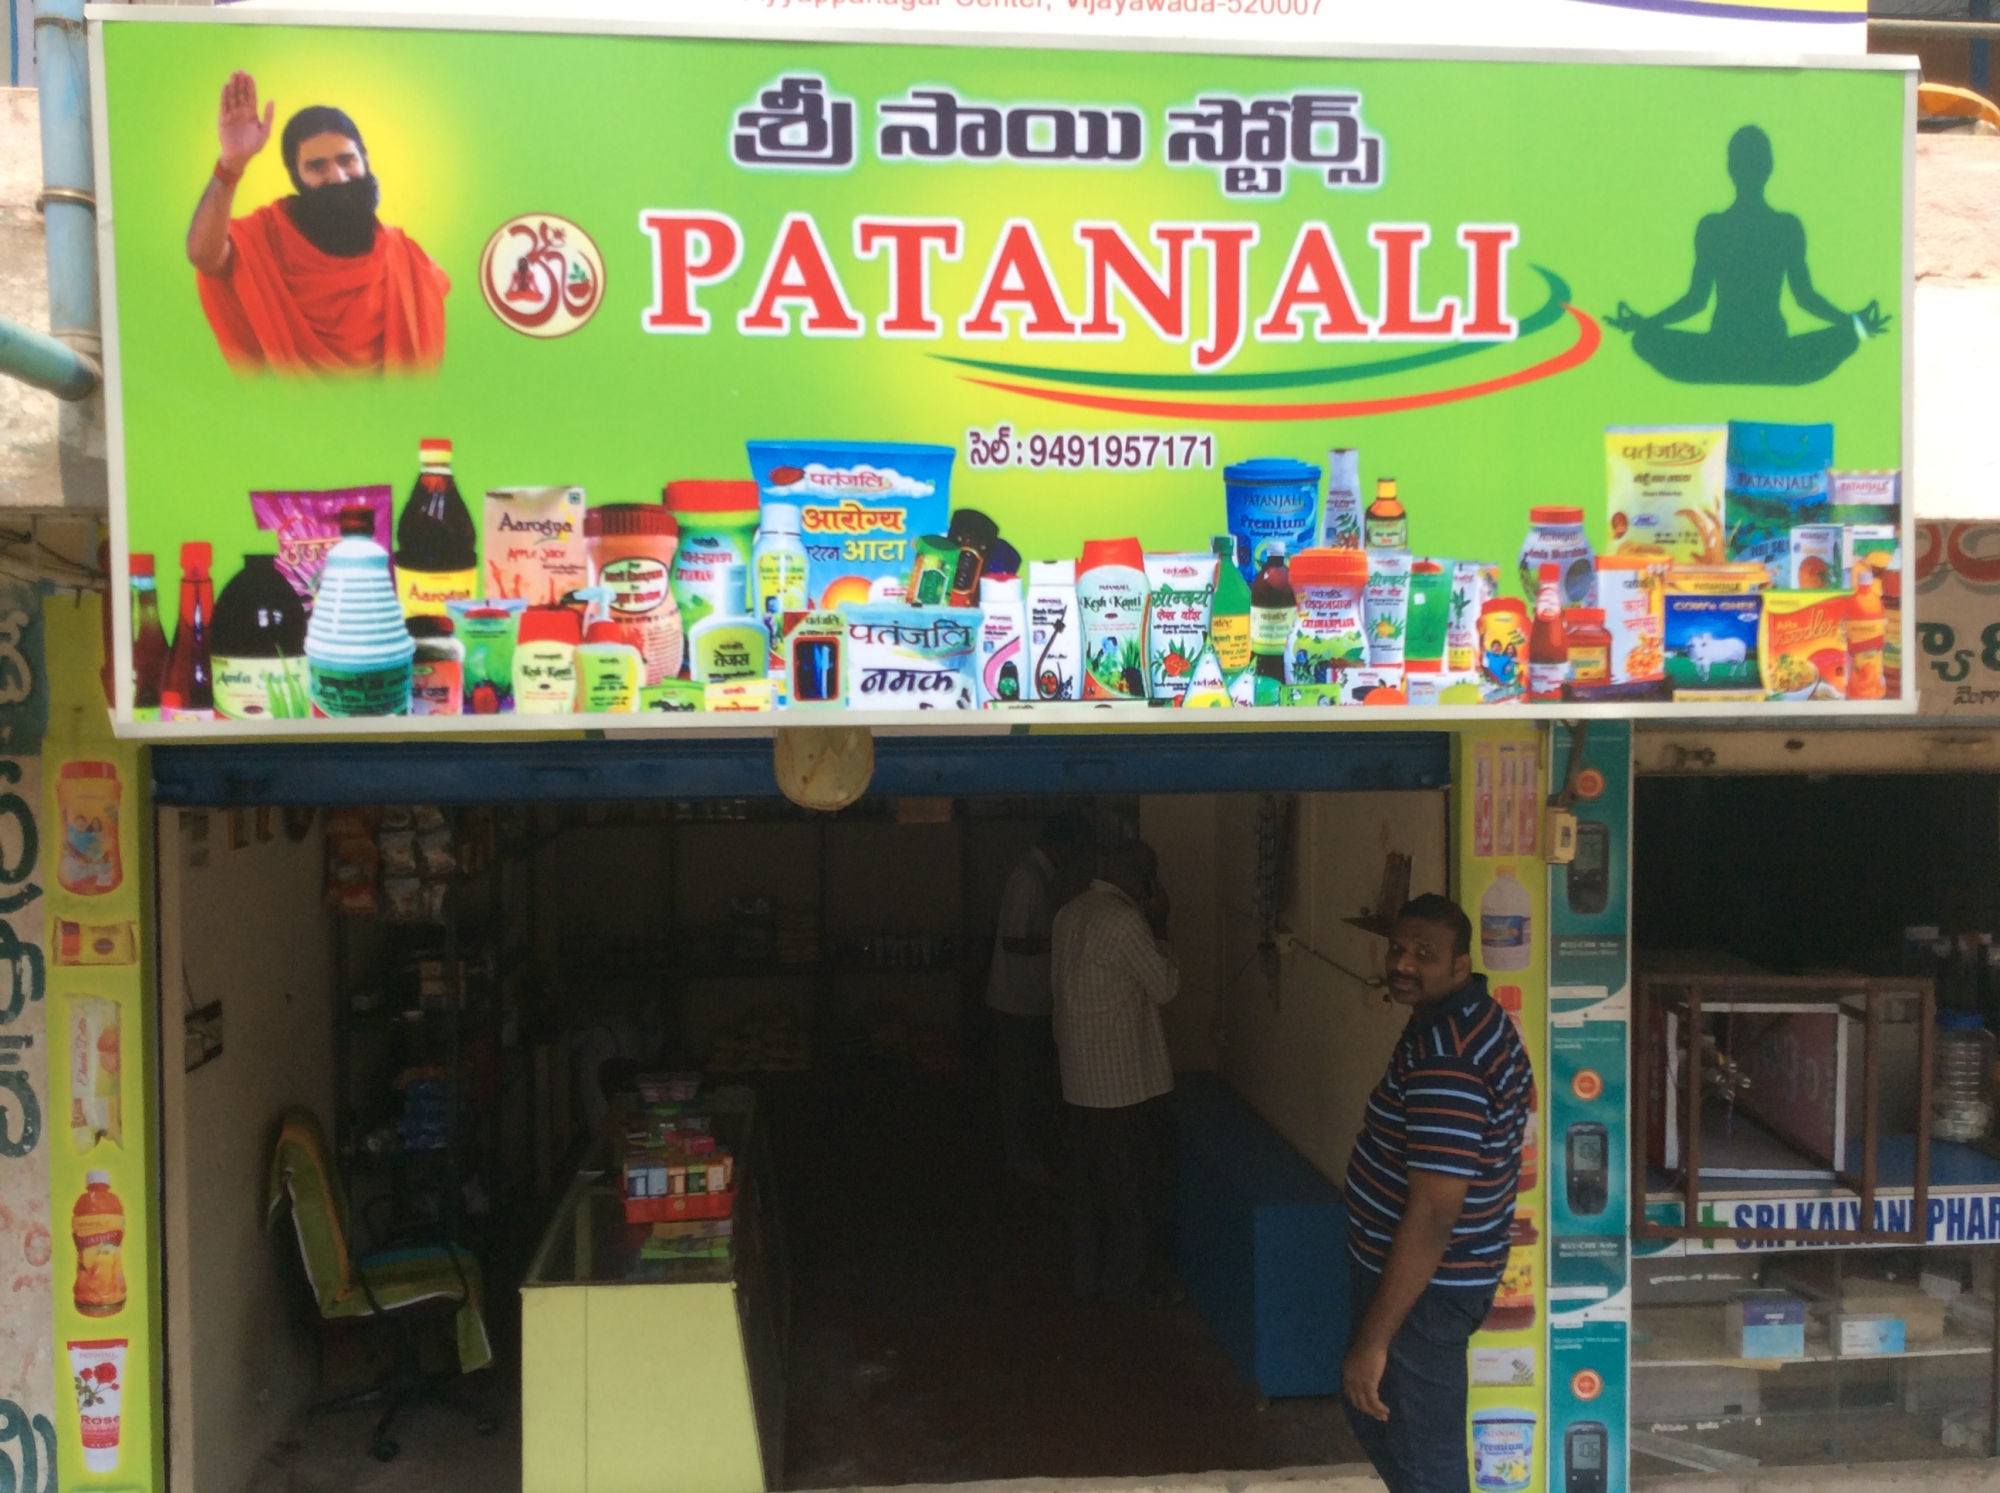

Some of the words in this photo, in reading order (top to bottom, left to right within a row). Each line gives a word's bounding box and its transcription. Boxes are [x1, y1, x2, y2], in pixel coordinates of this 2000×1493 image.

[734, 77, 853, 165] శ్రీ
[879, 90, 1142, 161] సాయి
[1167, 94, 1381, 194] స్టోర్స్
[645, 215, 1515, 367] PATANJALI
[1029, 434, 1213, 467] 9491957171
[809, 471, 884, 488] पतंजलि
[1737, 471, 1815, 490] PATANJALI
[498, 512, 573, 536] Aarogya
[802, 501, 905, 533] आरोग्य
[1240, 515, 1306, 530] Premium
[842, 539, 907, 562] आटा
[848, 618, 974, 649] पतंजलि
[860, 667, 960, 693] नमक
[1734, 1202, 1786, 1250] SRI
